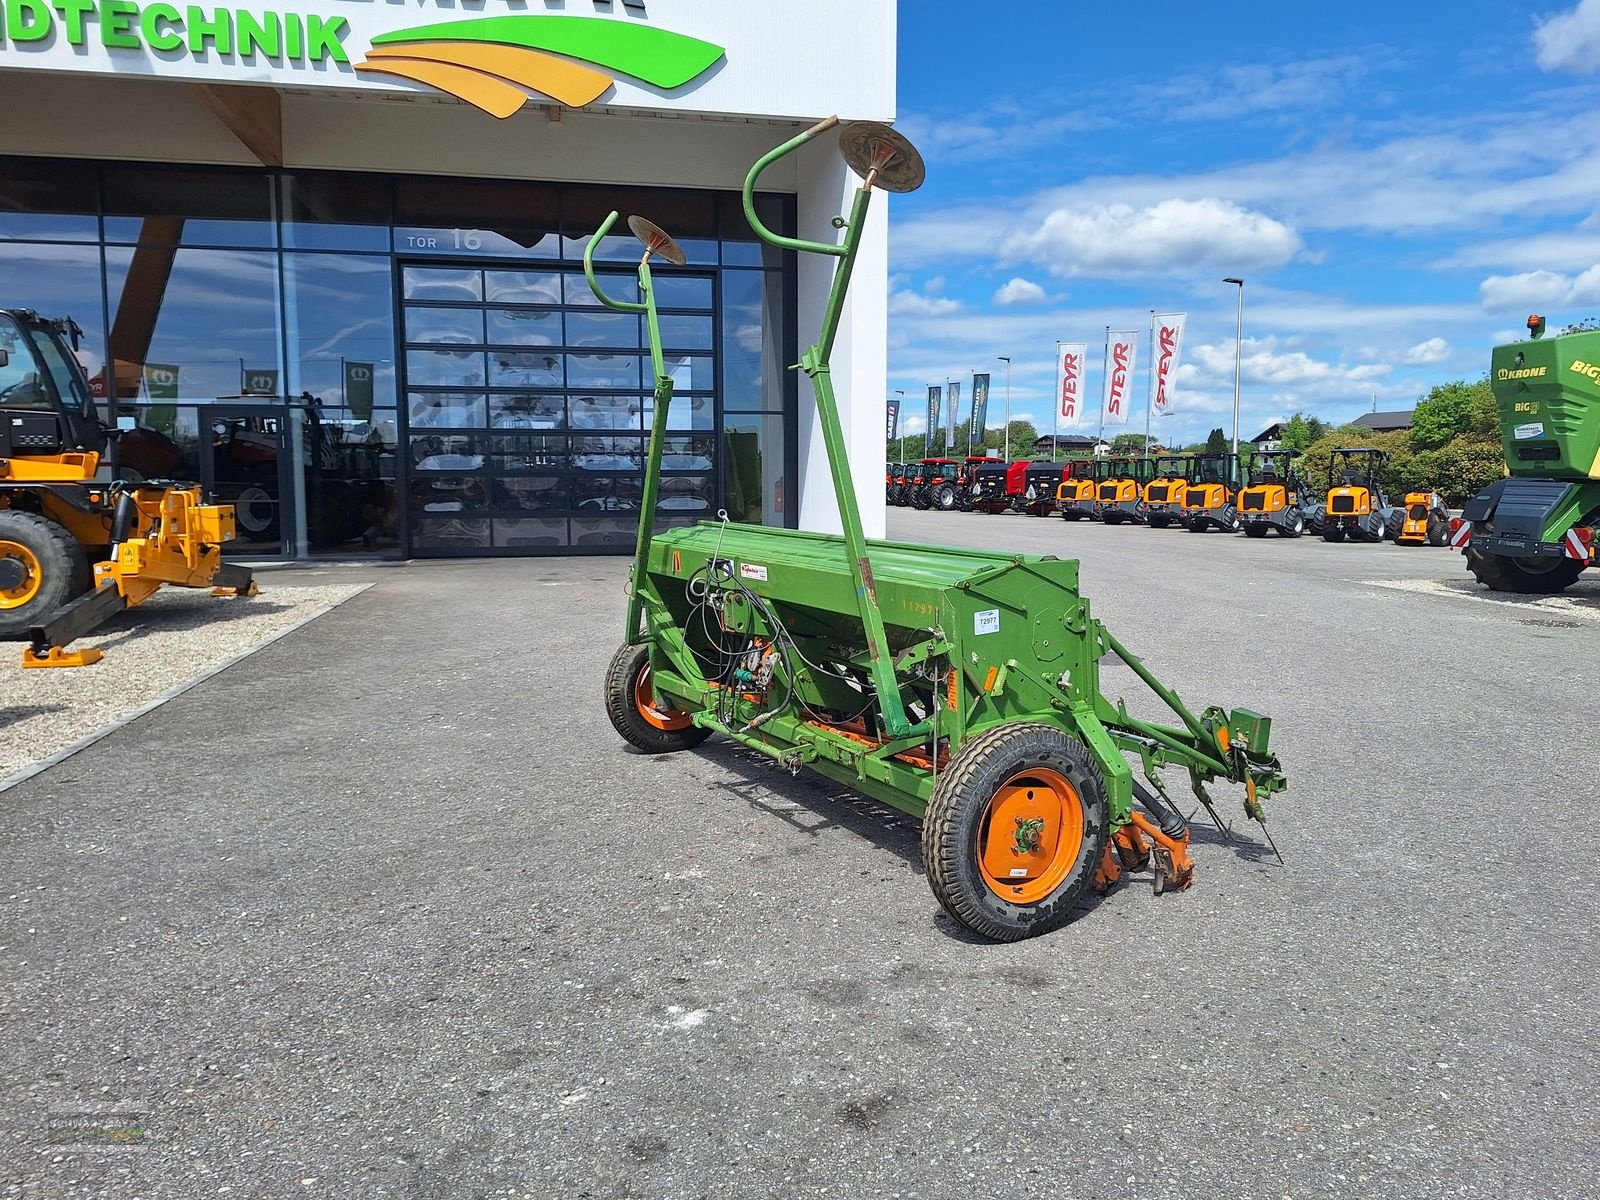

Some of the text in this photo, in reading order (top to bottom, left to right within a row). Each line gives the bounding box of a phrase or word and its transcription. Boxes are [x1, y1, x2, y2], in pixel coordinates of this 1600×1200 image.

[0, 0, 351, 62] DTECHNIK
[407, 228, 482, 250] TOR 16
[1061, 353, 1078, 419] STEYR
[1108, 342, 1128, 416] STEYR
[1156, 326, 1175, 406] STEYR
[1508, 367, 1547, 380] KRONE
[1514, 402, 1530, 412] BiG
[980, 616, 997, 625] 72977
